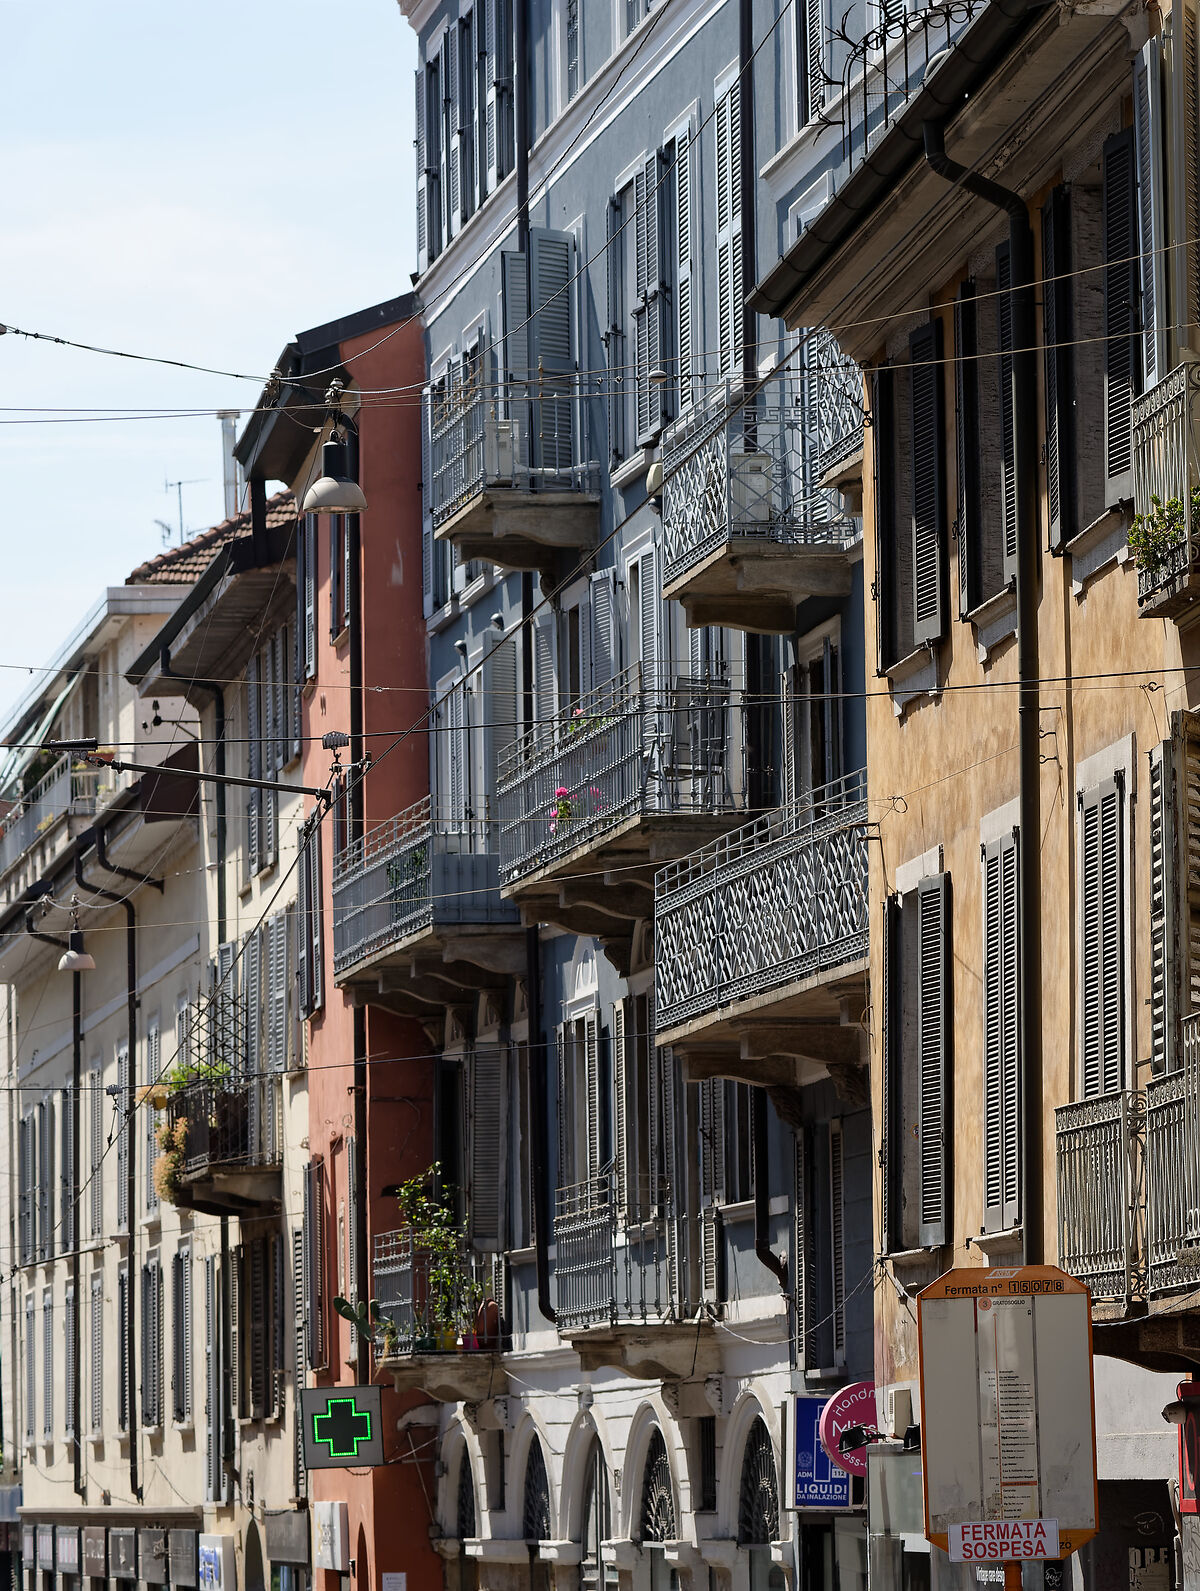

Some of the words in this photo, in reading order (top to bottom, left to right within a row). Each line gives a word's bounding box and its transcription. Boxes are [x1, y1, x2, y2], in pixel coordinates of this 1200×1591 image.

[945, 1284, 988, 1295] Fermata
[1009, 1280, 1064, 1293] 15078
[796, 1484, 847, 1494] LIQUIDI
[961, 1522, 1047, 1541] FERMATA
[962, 1540, 1047, 1559] SOSPESA
